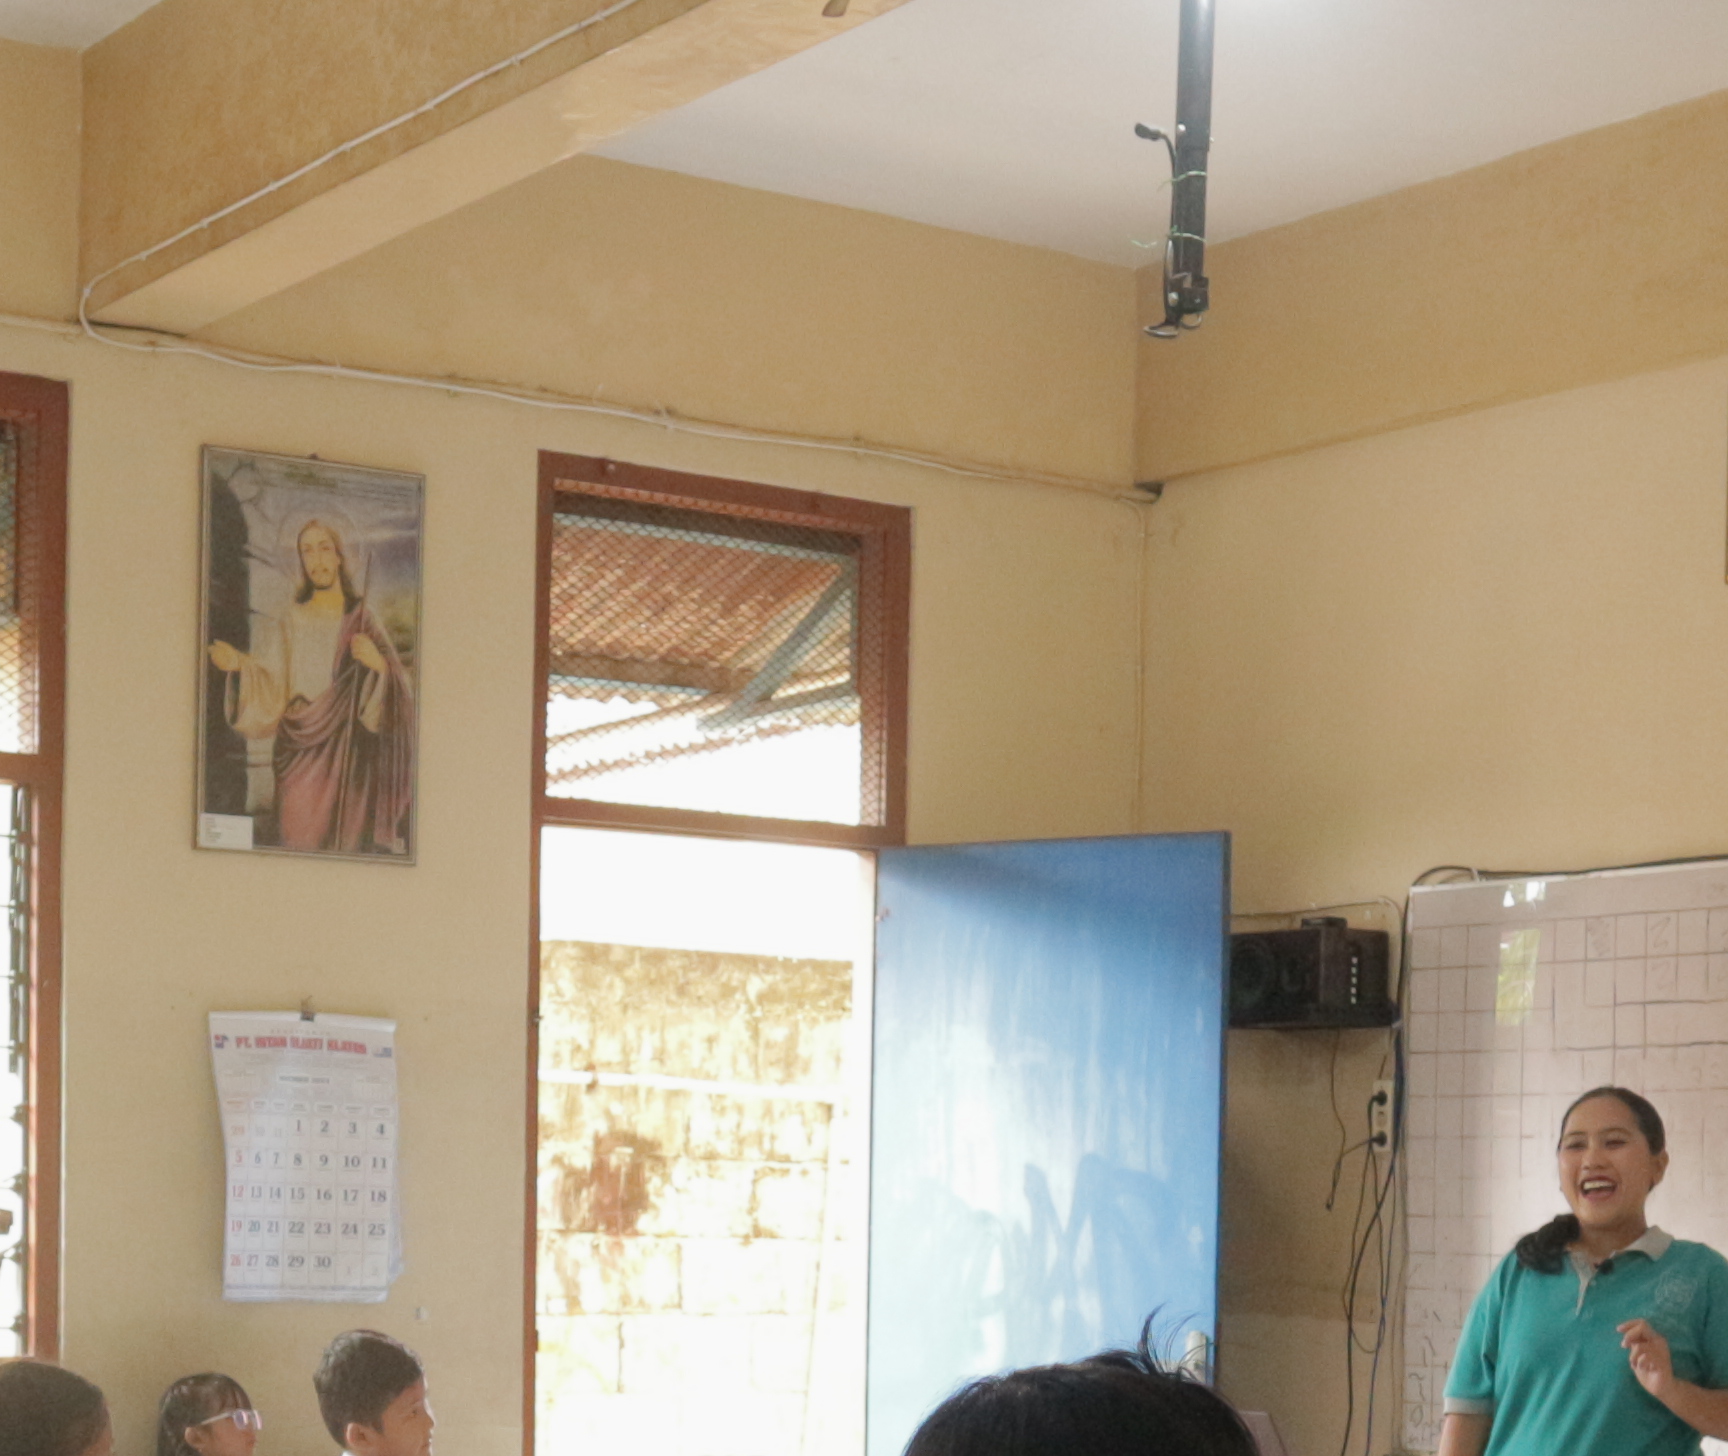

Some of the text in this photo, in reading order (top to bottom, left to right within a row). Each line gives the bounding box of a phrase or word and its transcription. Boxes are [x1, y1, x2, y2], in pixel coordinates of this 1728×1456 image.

[295, 1119, 302, 1133] 1
[320, 1120, 330, 1133] 2
[347, 1121, 358, 1134] 3
[375, 1123, 386, 1136] 4
[235, 1151, 387, 1170] 5 6 7 8 9 10 11
[232, 1185, 387, 1203] 12 13 14 15 16 17 18
[231, 1220, 386, 1237] 19 20 21 22 23 24 25
[230, 1254, 242, 1267] 26
[246, 1254, 259, 1267] 27
[265, 1255, 279, 1267] 28
[287, 1255, 305, 1268] 29
[313, 1256, 332, 1268] 30
